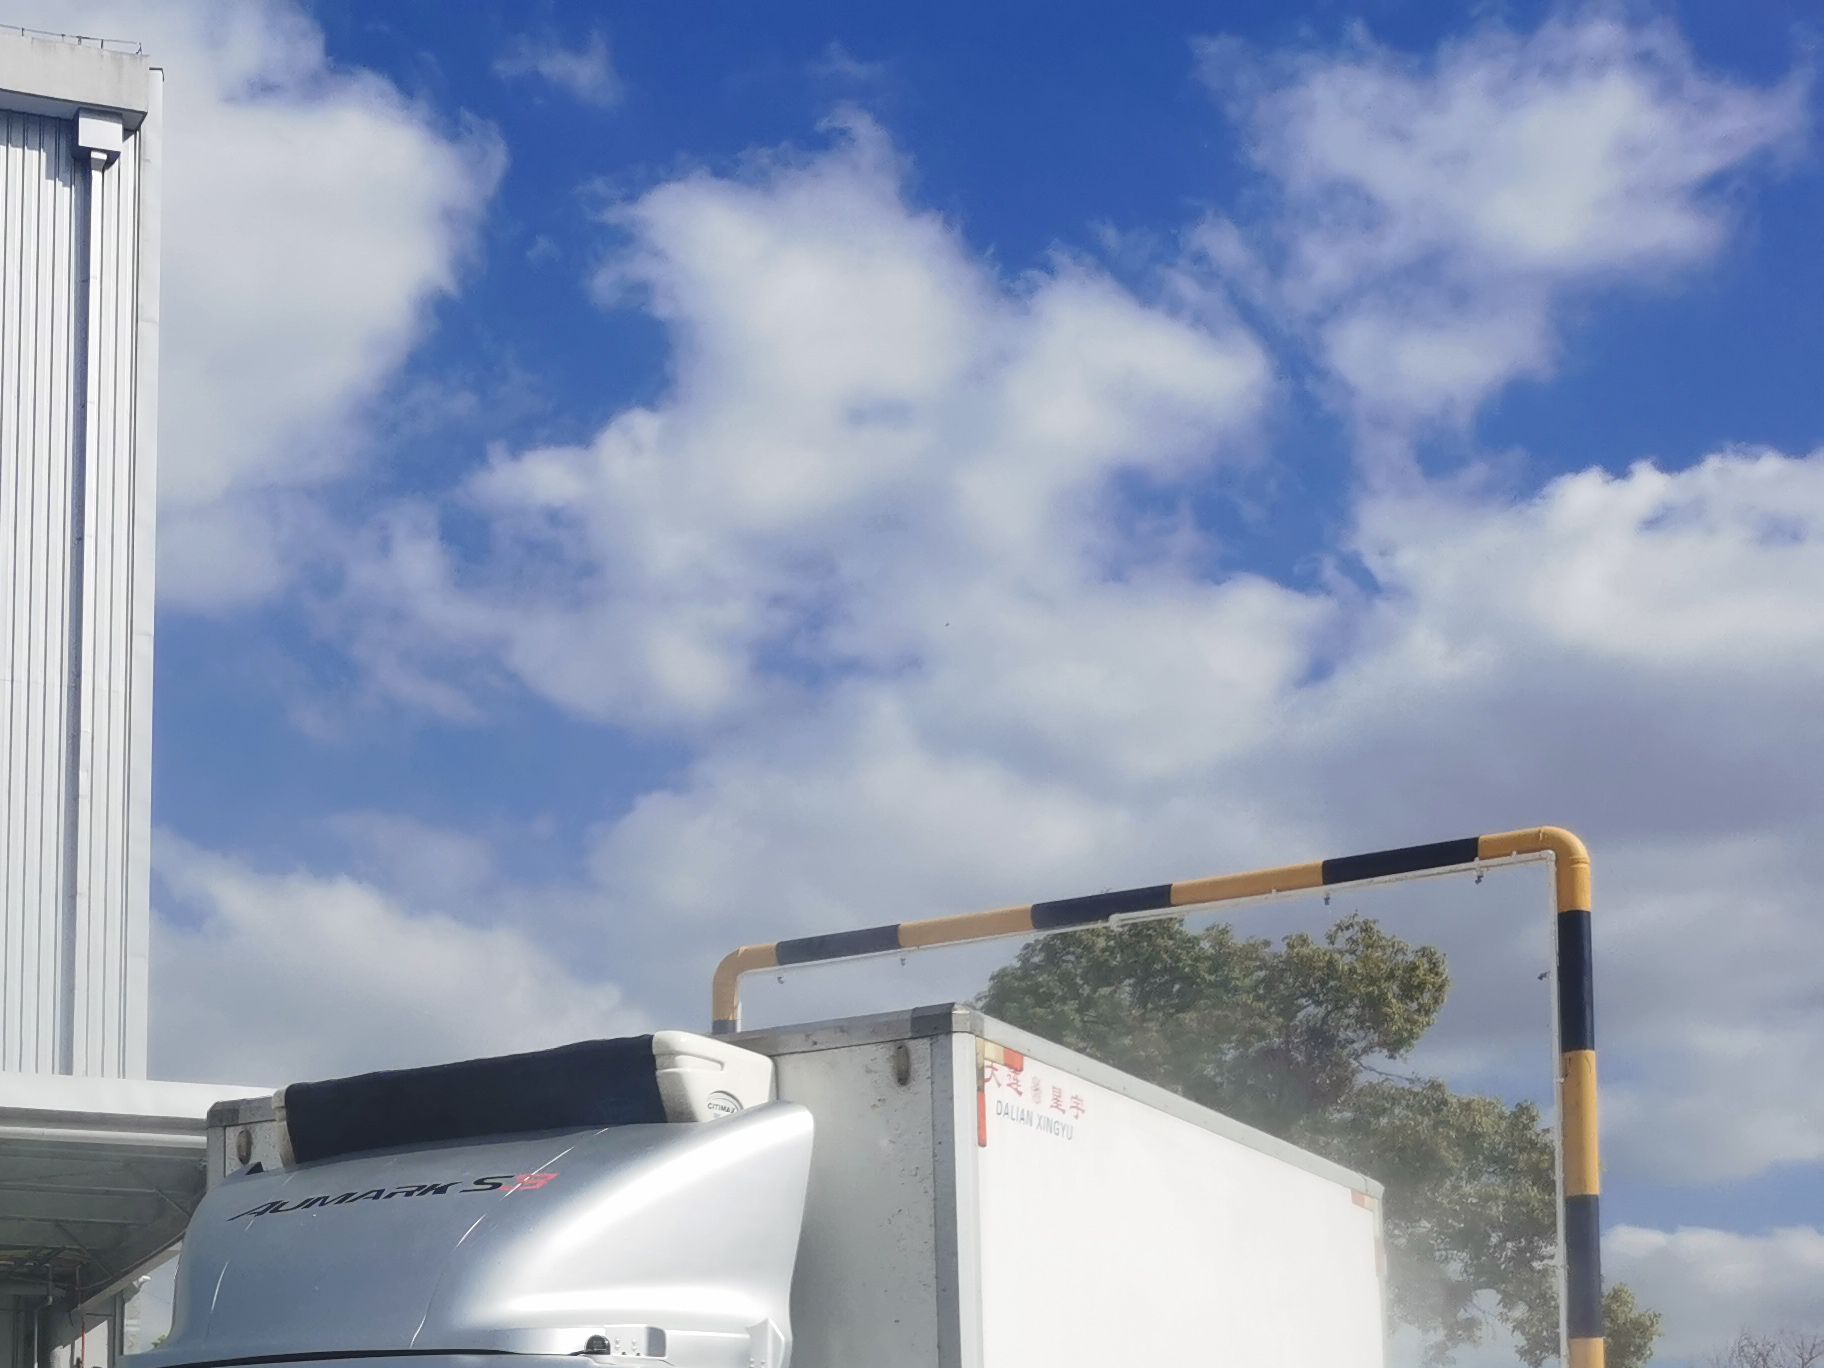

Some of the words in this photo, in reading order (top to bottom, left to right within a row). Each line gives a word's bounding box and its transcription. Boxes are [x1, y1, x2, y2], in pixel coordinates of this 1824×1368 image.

[996, 1099, 1033, 1127] DALIAN
[1036, 1112, 1074, 1141] XINGYU
[226, 1181, 463, 1222] AUMARK
